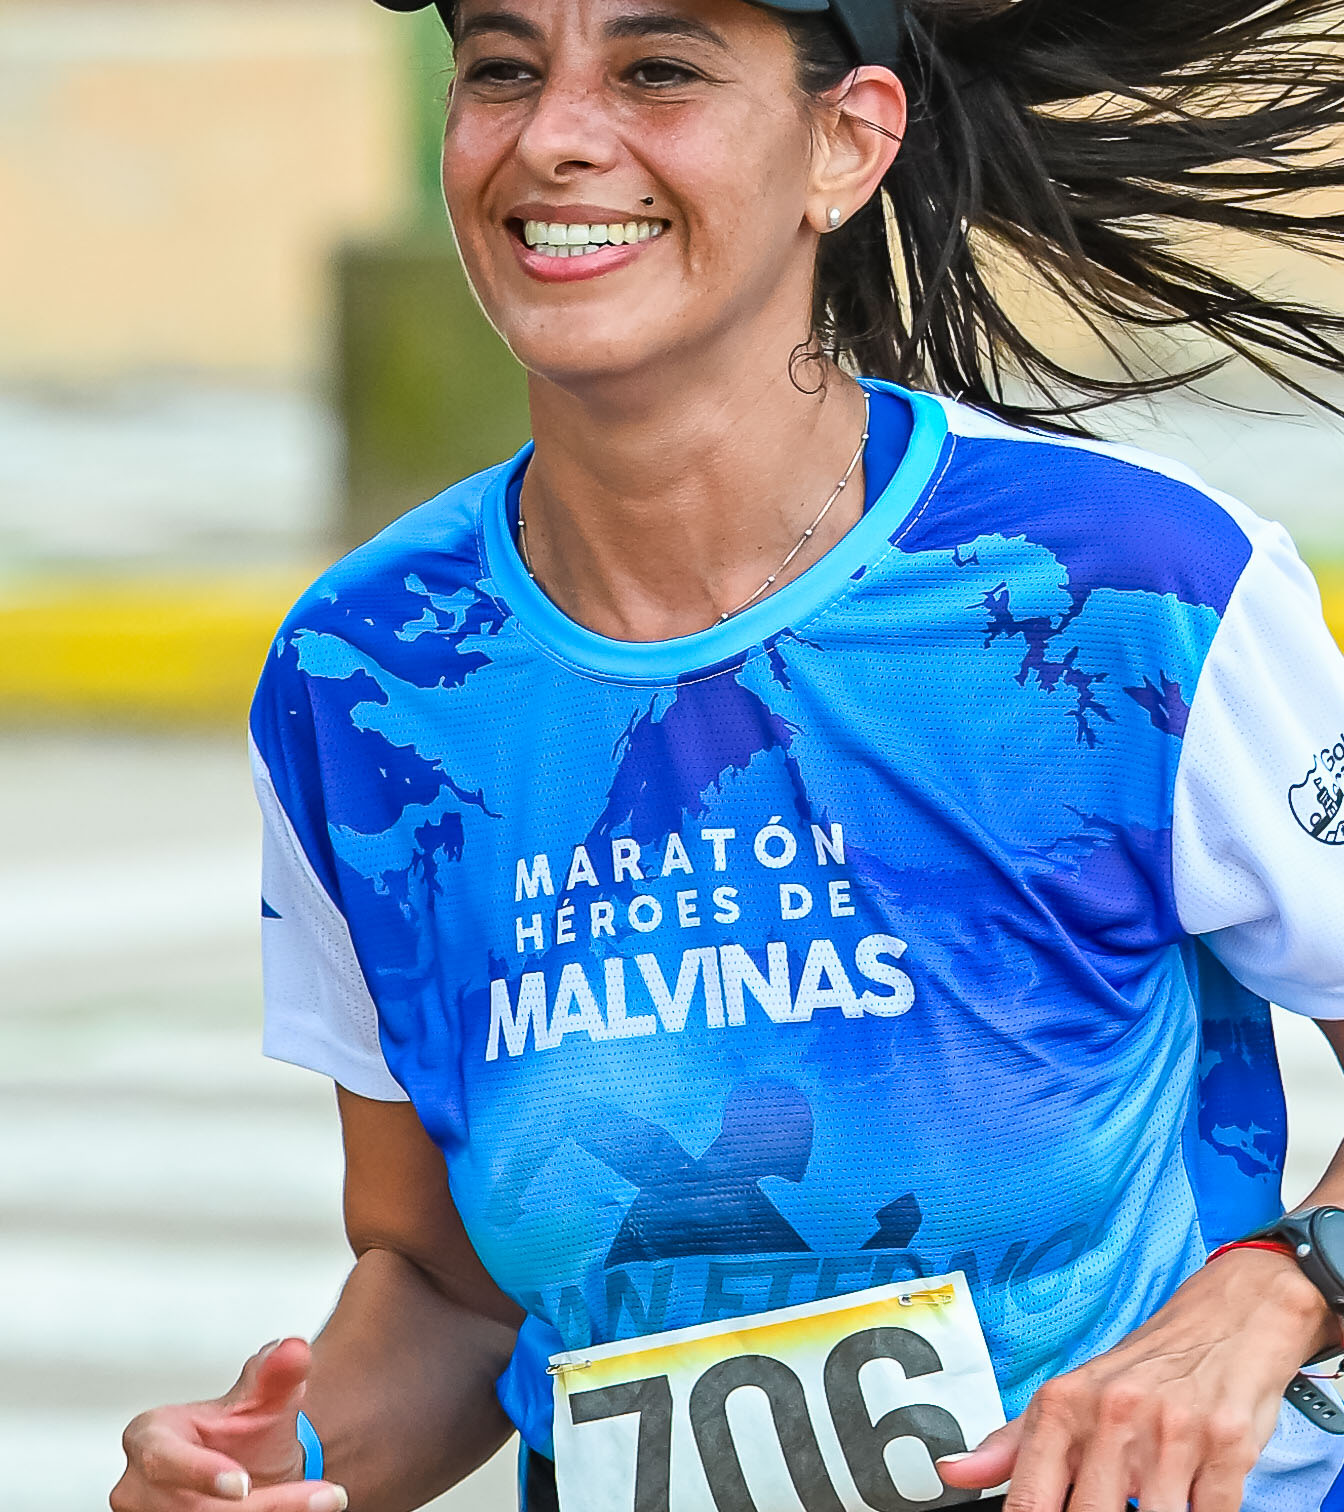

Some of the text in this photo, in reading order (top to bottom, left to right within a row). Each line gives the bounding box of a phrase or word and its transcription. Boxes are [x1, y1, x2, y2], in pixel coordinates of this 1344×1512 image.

[514, 815, 847, 902] MARATÓN
[515, 880, 857, 953] HÉROES DE
[485, 933, 916, 1061] MALVINAS
